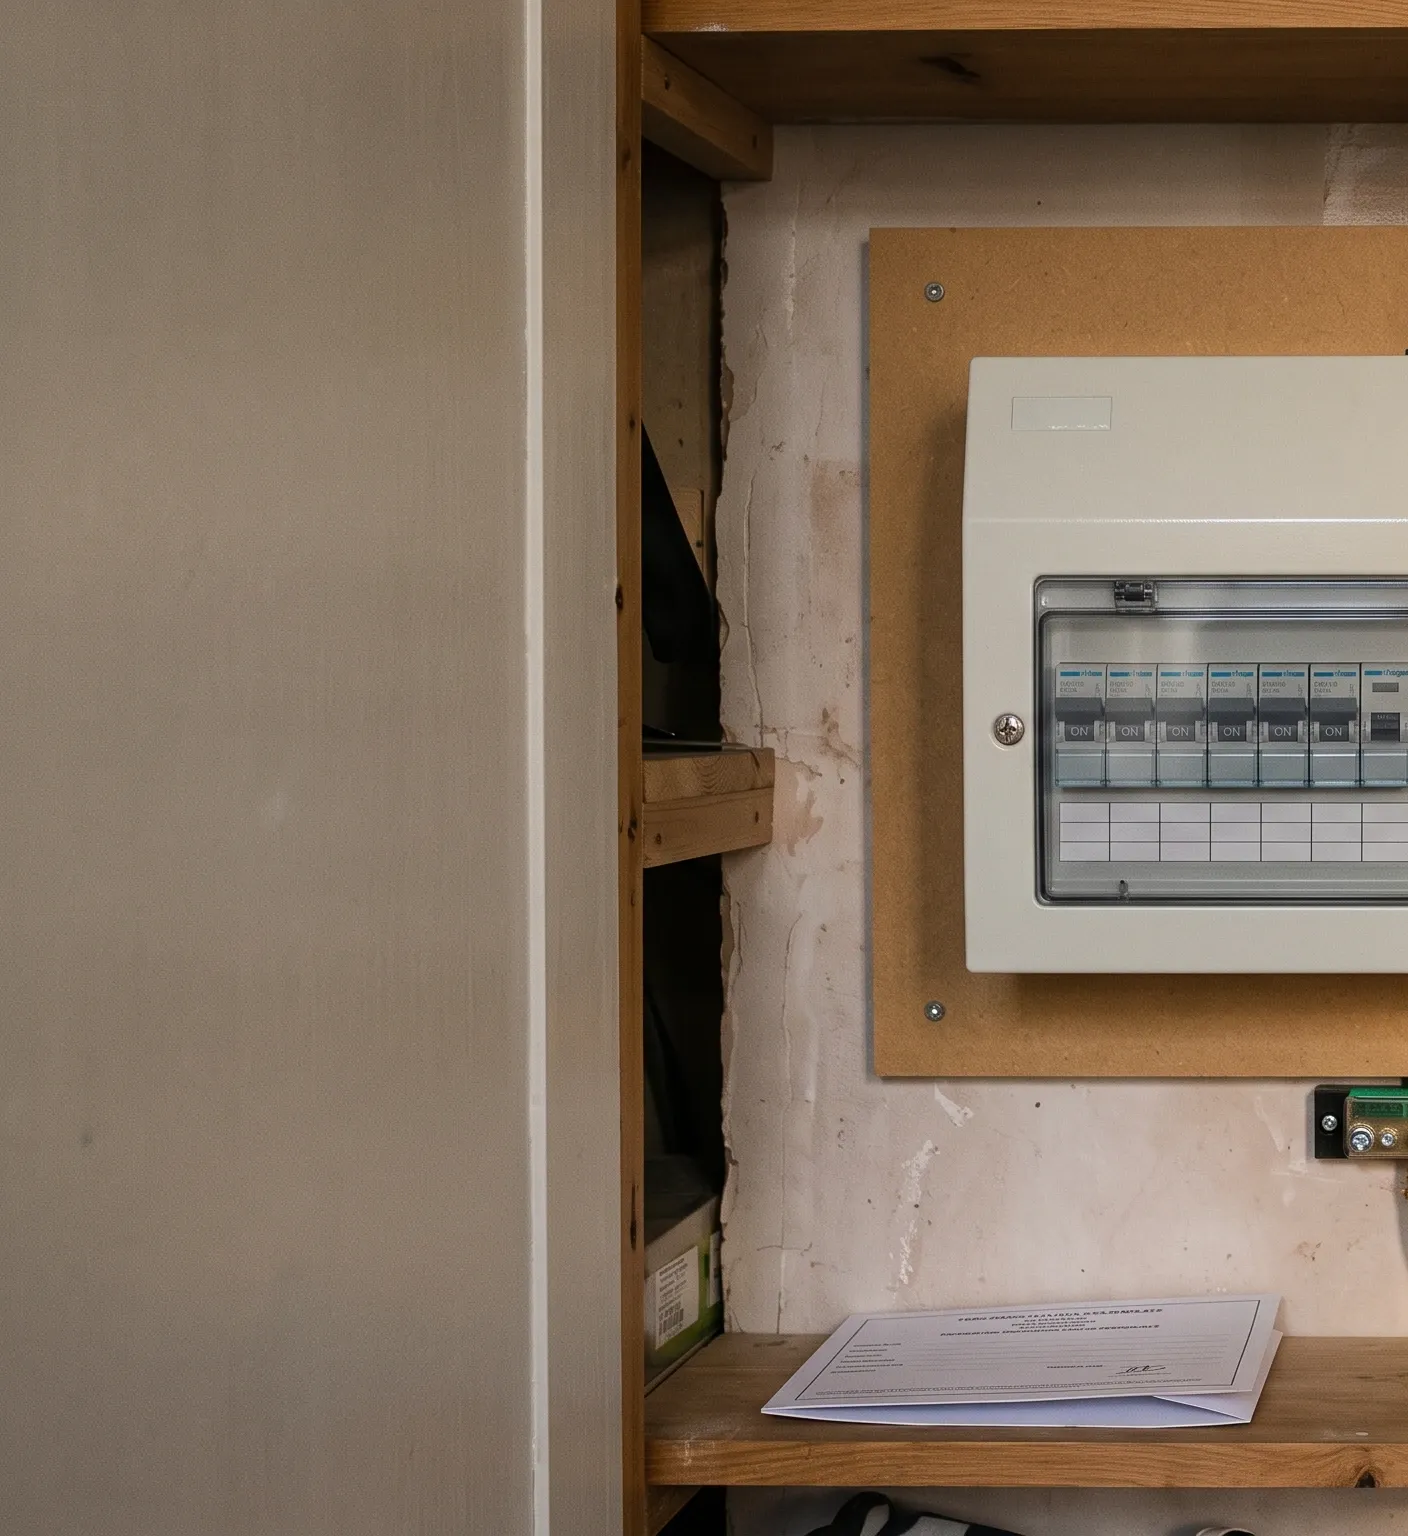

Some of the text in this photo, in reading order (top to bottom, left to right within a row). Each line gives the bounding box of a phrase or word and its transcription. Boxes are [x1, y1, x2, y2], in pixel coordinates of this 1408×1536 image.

[1070, 726, 1089, 737] ON
[1121, 726, 1139, 737] ON
[1171, 726, 1189, 737] ON
[1223, 726, 1240, 737] ON
[1274, 726, 1292, 737] ON
[1325, 726, 1342, 737] ON
